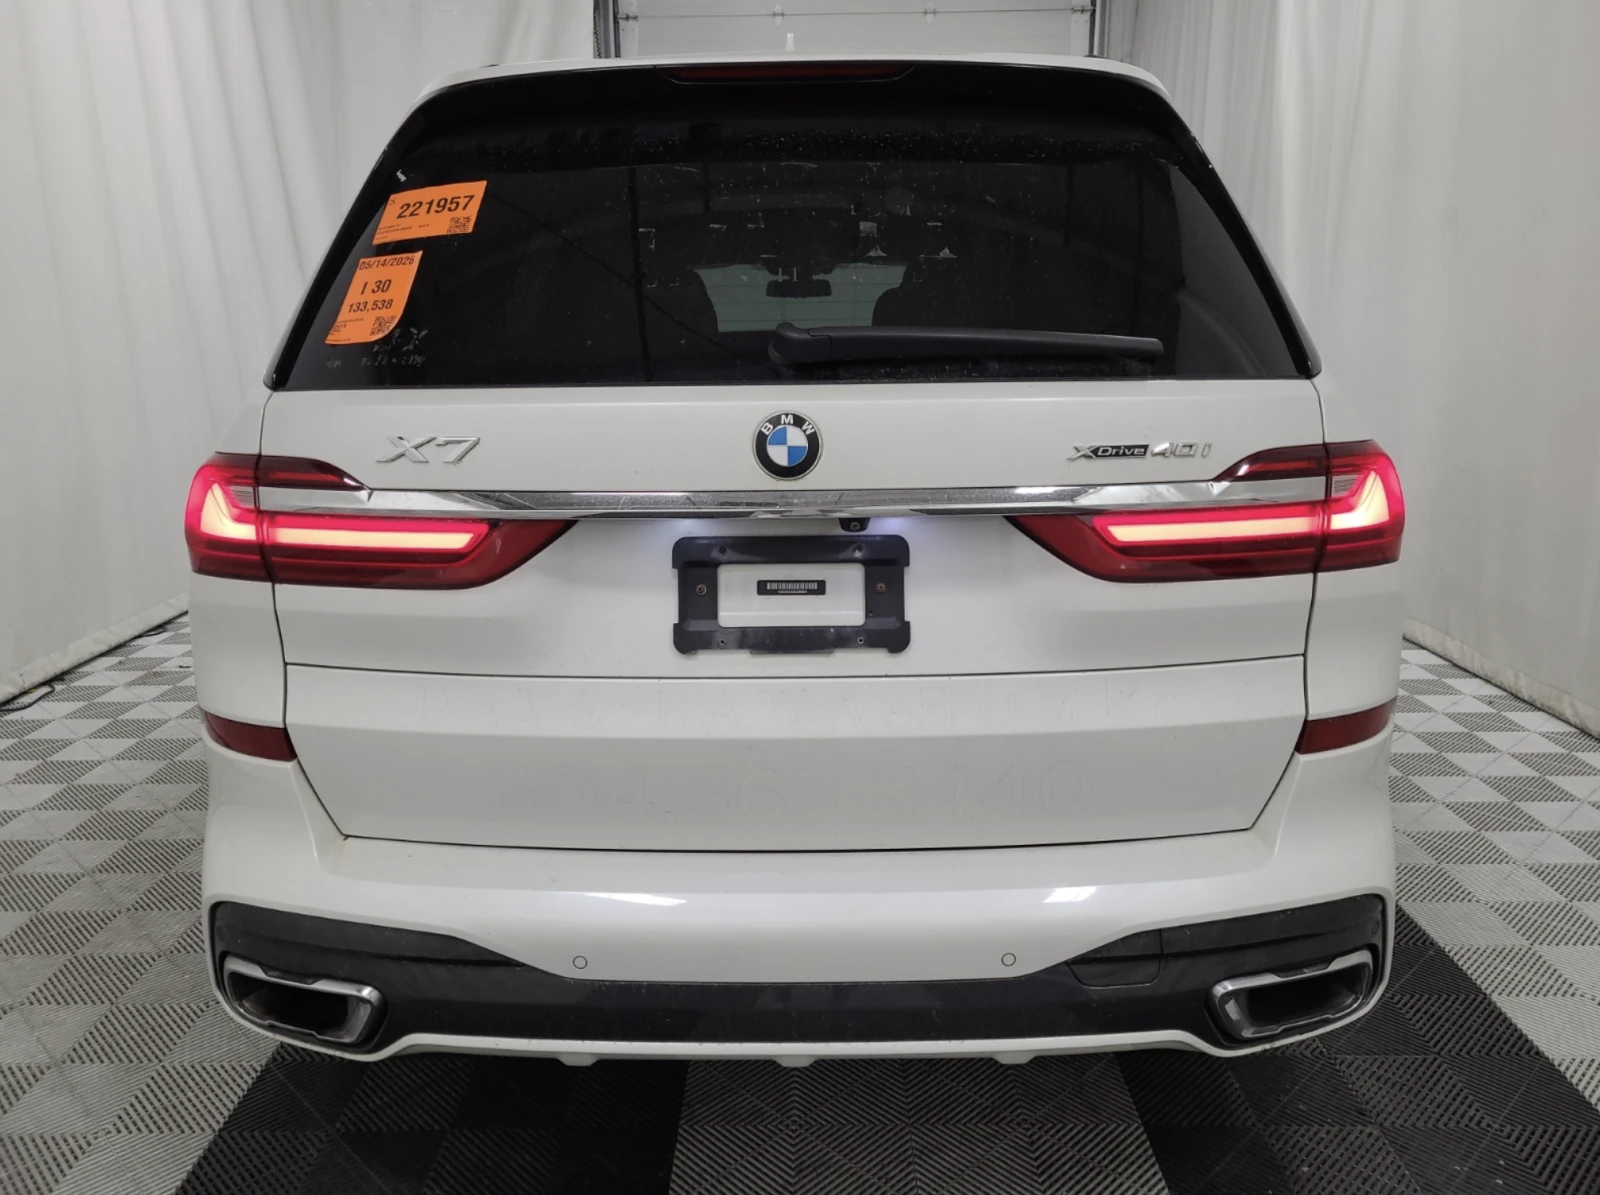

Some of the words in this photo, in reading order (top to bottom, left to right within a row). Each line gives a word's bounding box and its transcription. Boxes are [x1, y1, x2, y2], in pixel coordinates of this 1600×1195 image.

[396, 195, 475, 220] 221957
[359, 255, 415, 271] 05/14/2026
[371, 279, 392, 294] 30
[347, 298, 394, 314] 133,538
[760, 413, 816, 436] BMW
[376, 436, 480, 463] X7
